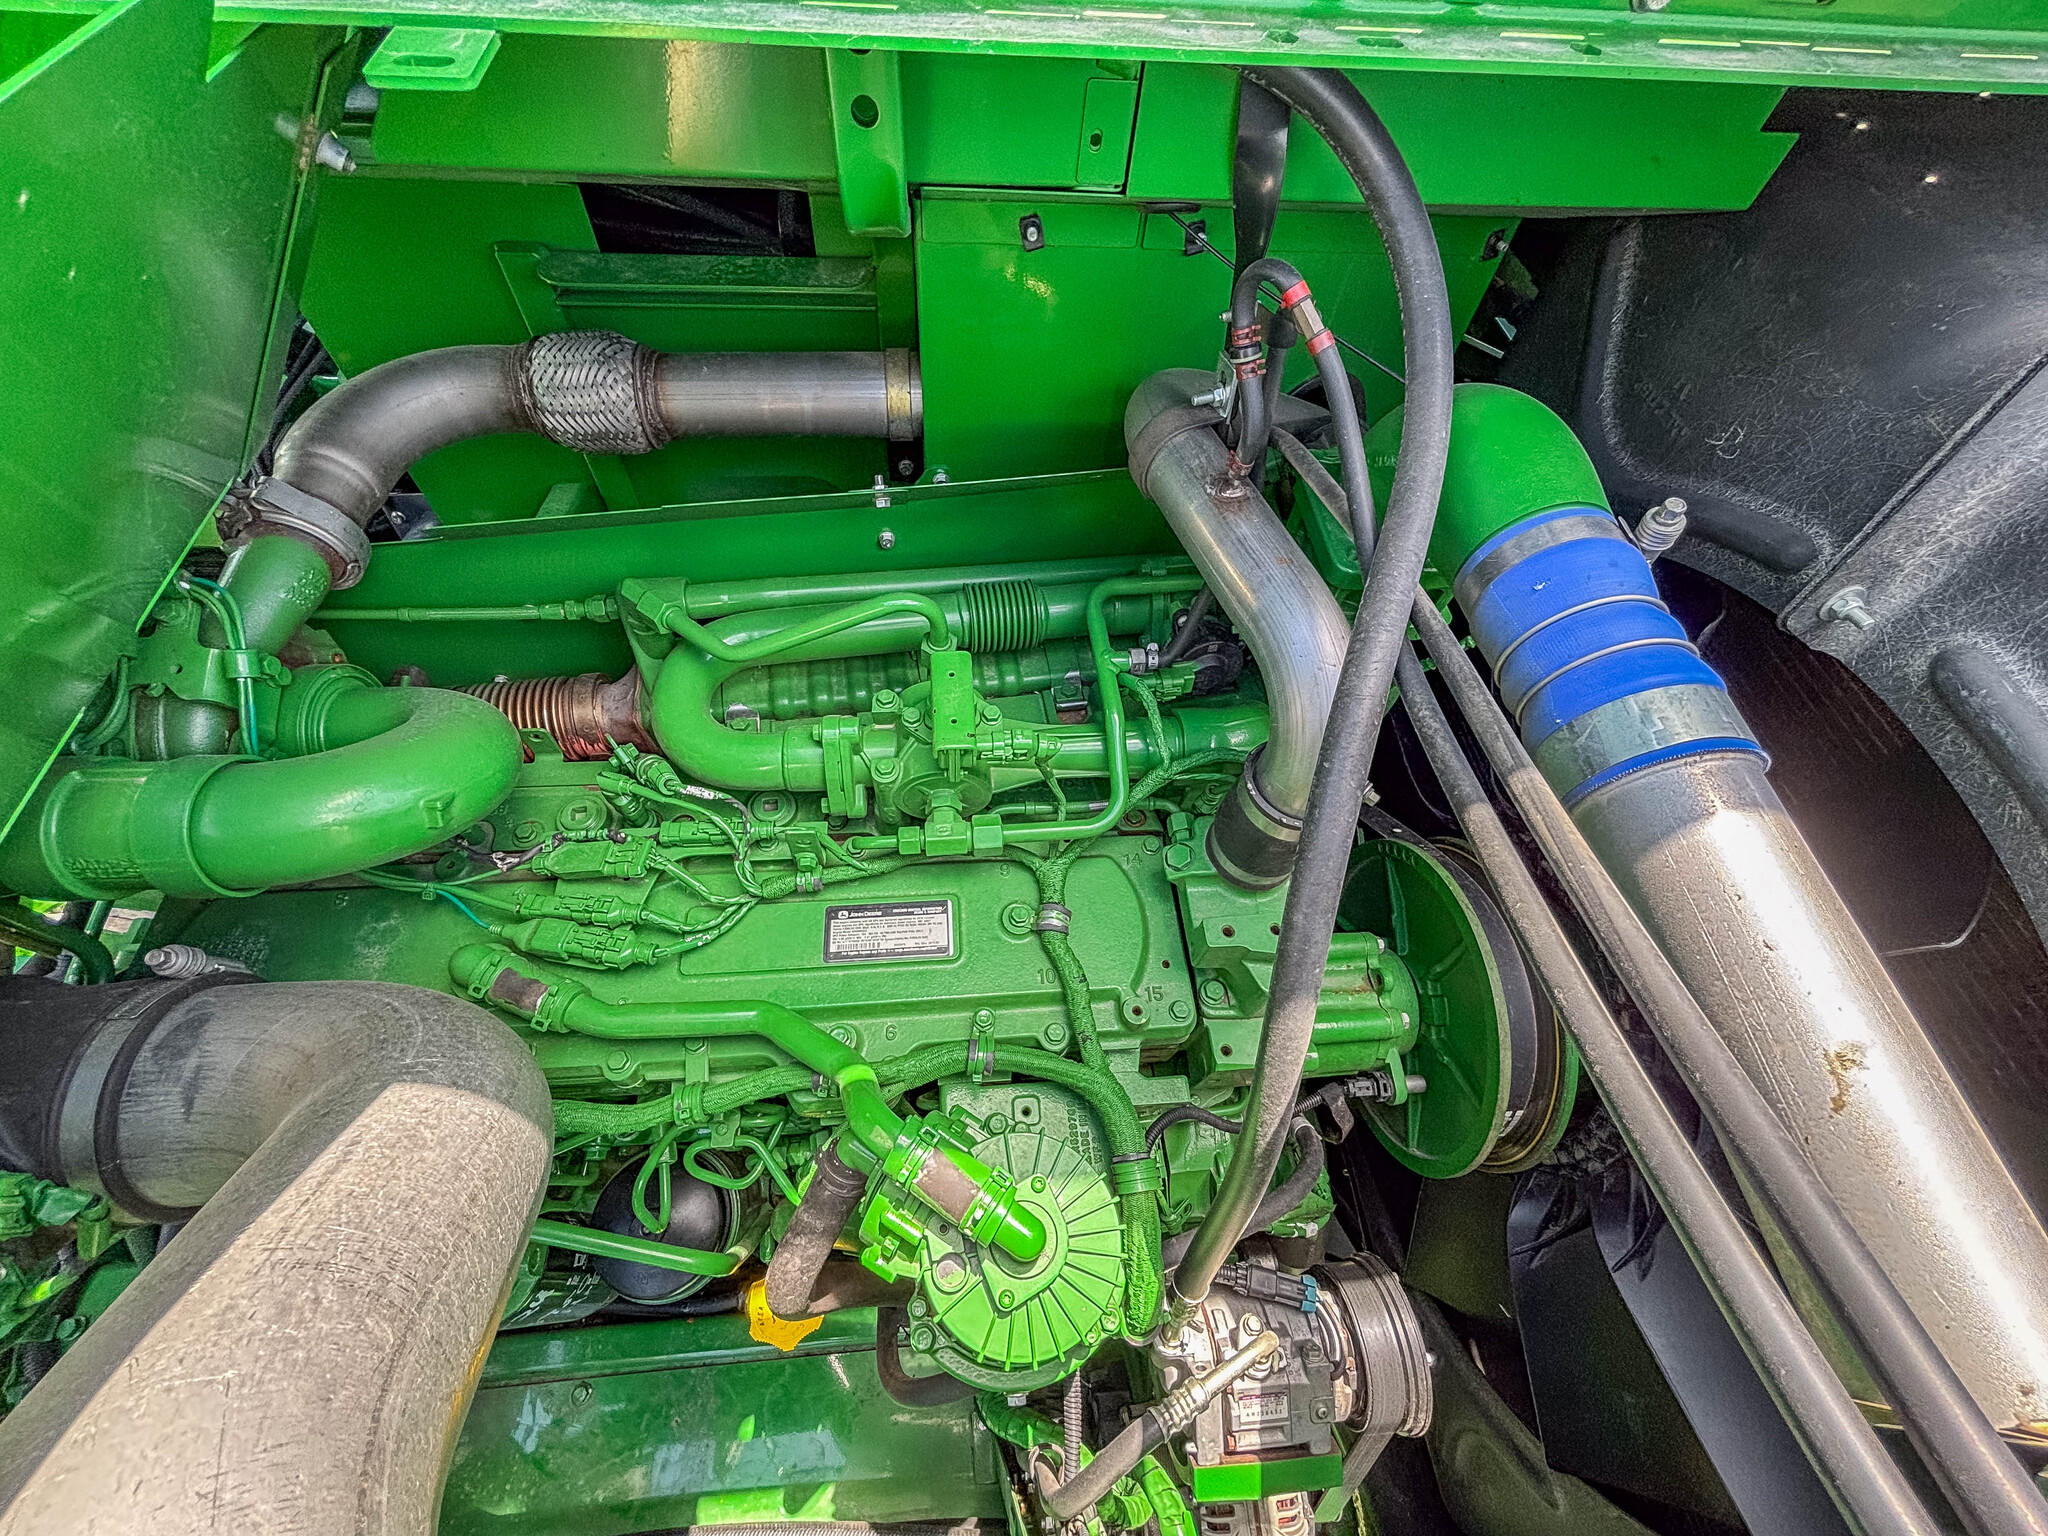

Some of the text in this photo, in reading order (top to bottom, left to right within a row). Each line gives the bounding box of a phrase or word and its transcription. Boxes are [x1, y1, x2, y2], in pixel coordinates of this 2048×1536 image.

[1124, 853, 1143, 866] 14
[1000, 863, 1011, 878] 9
[1037, 968, 1057, 985] 10
[1144, 985, 1164, 1002] 15
[885, 1024, 898, 1041] 6
